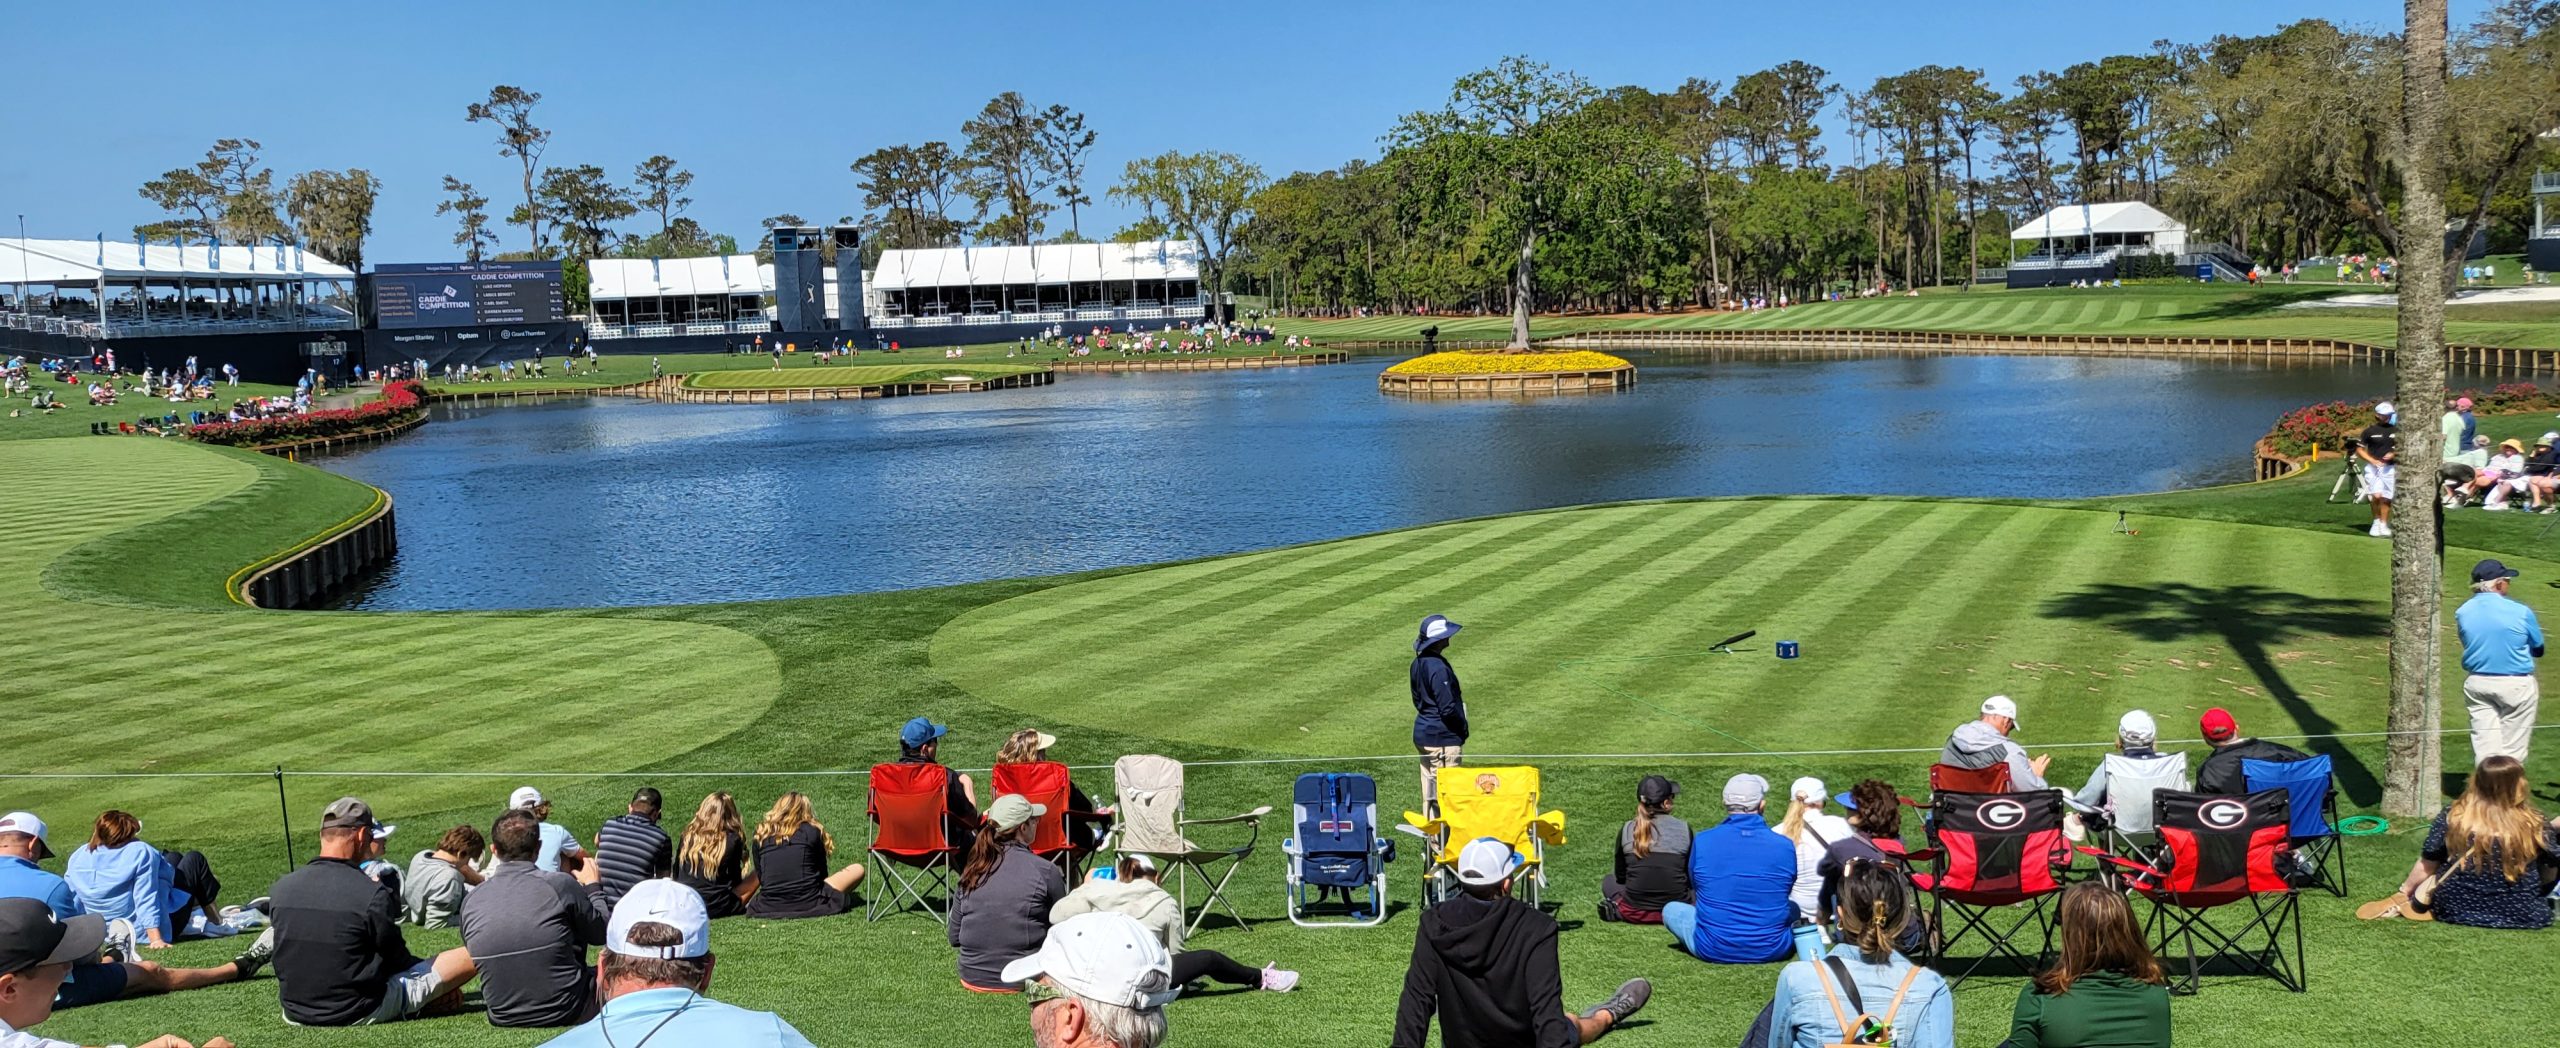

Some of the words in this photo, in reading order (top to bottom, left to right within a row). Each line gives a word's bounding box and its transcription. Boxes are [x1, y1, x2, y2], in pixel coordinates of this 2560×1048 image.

[498, 272, 544, 280] COMPETITION
[418, 295, 447, 303] CADDIE
[418, 301, 470, 310] COMPETITION
[457, 332, 479, 340] Optum
